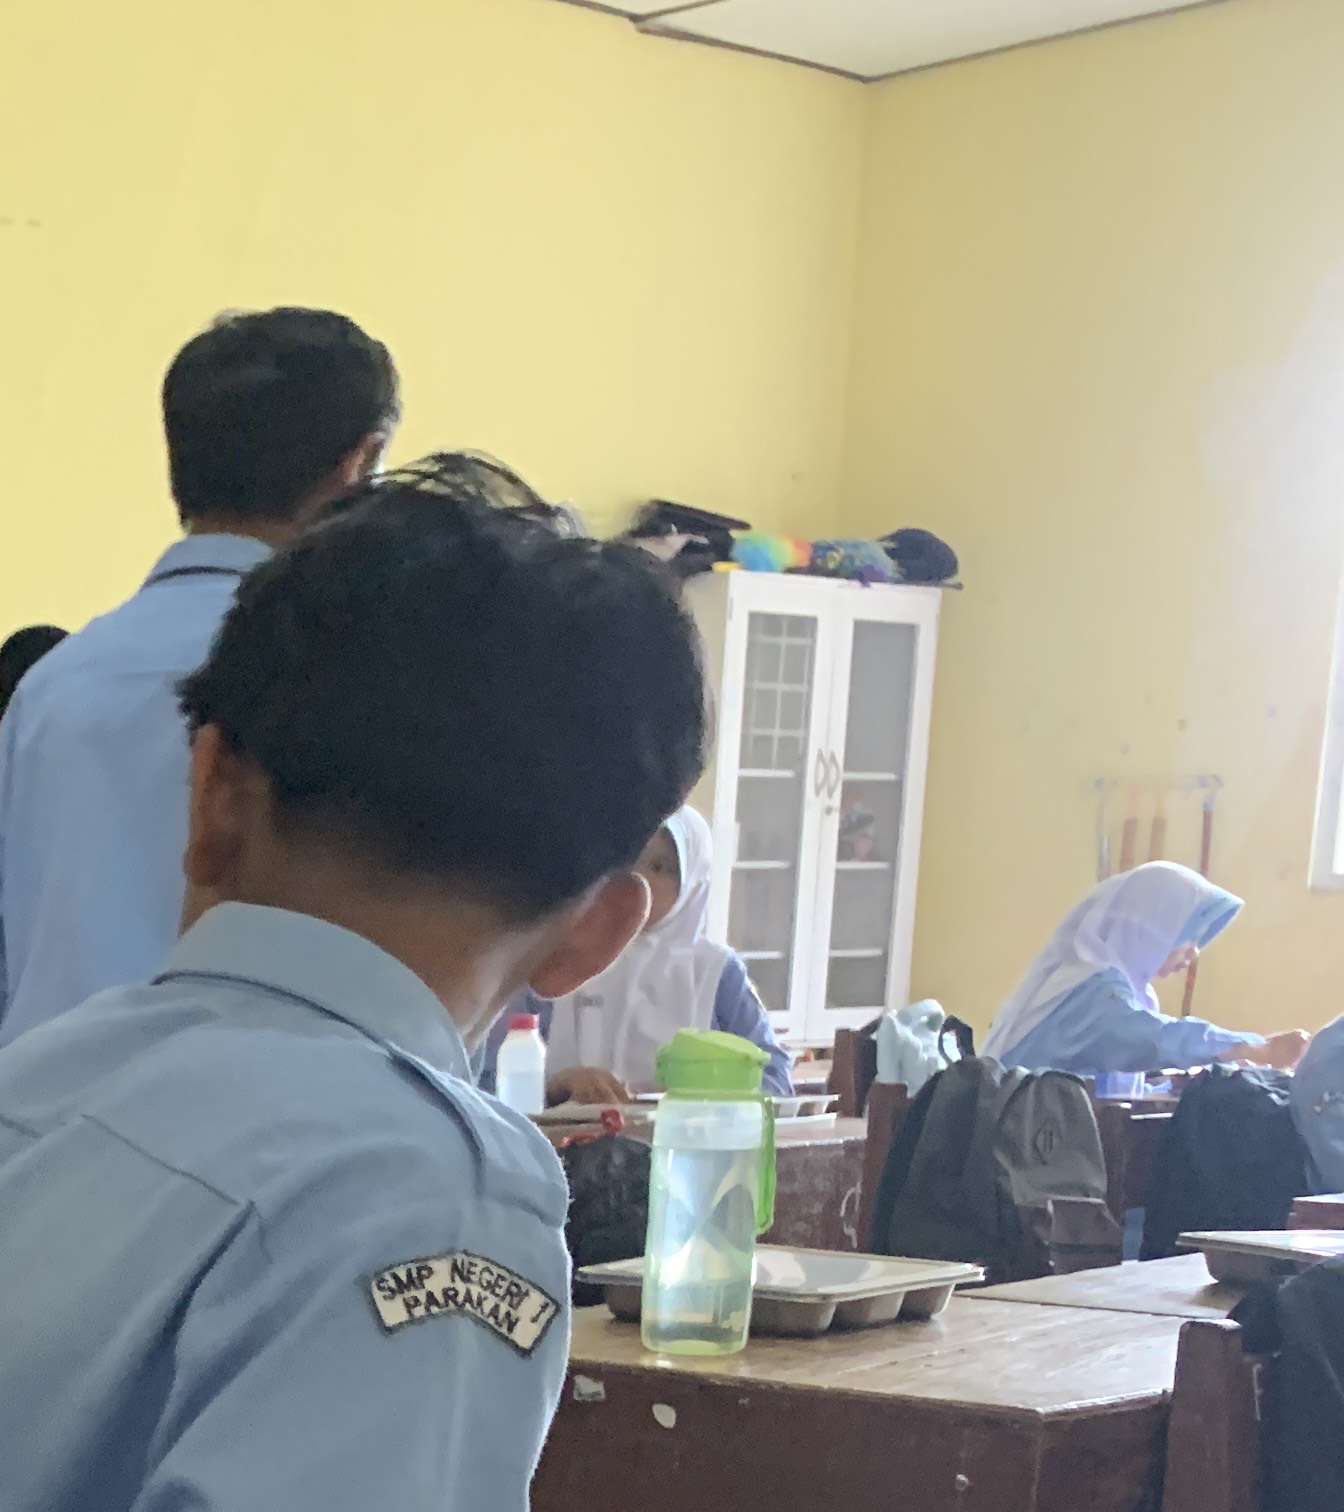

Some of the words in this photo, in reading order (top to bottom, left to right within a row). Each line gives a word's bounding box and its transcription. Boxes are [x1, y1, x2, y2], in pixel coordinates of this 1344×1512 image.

[375, 1264, 433, 1300] SMP
[450, 1258, 529, 1310] NEGERI
[403, 1286, 520, 1334] PARAKAN
